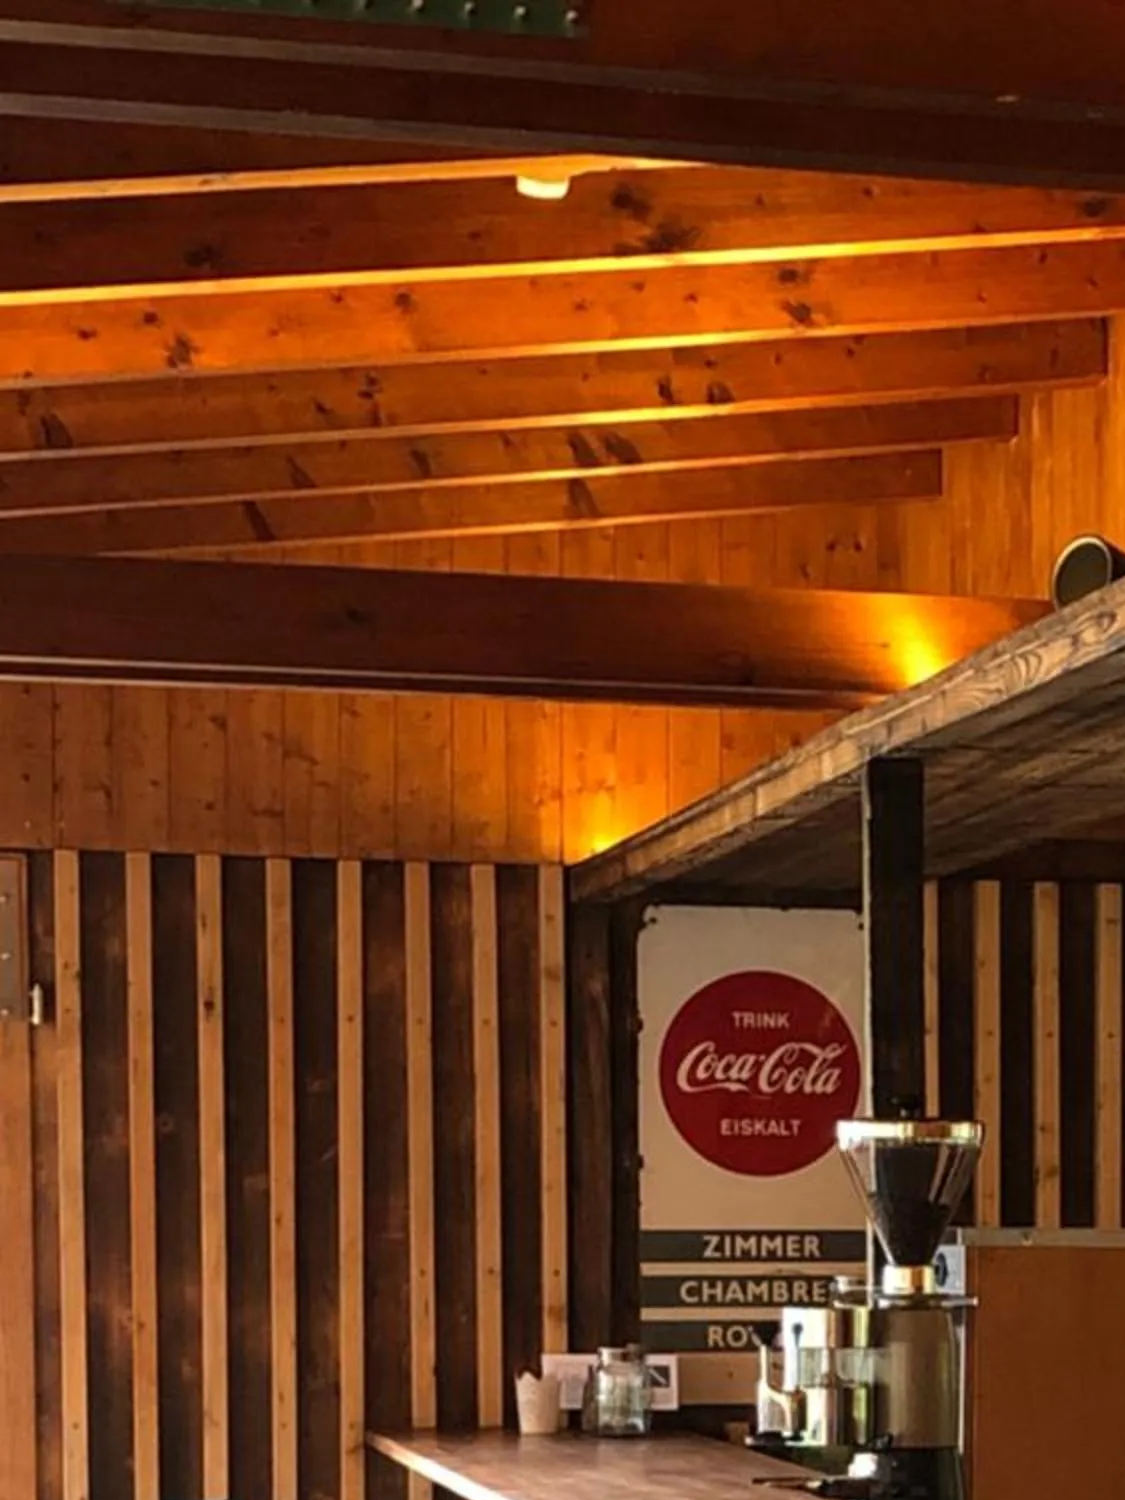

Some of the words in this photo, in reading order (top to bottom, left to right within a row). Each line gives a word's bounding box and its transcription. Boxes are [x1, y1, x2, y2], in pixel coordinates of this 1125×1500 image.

[732, 1011, 790, 1029] TRINK
[677, 1040, 847, 1095] Coca-Cola
[720, 1118, 801, 1136] EISKALT
[703, 1234, 822, 1258] ZIMMER
[679, 1280, 838, 1303] CHAMBRE
